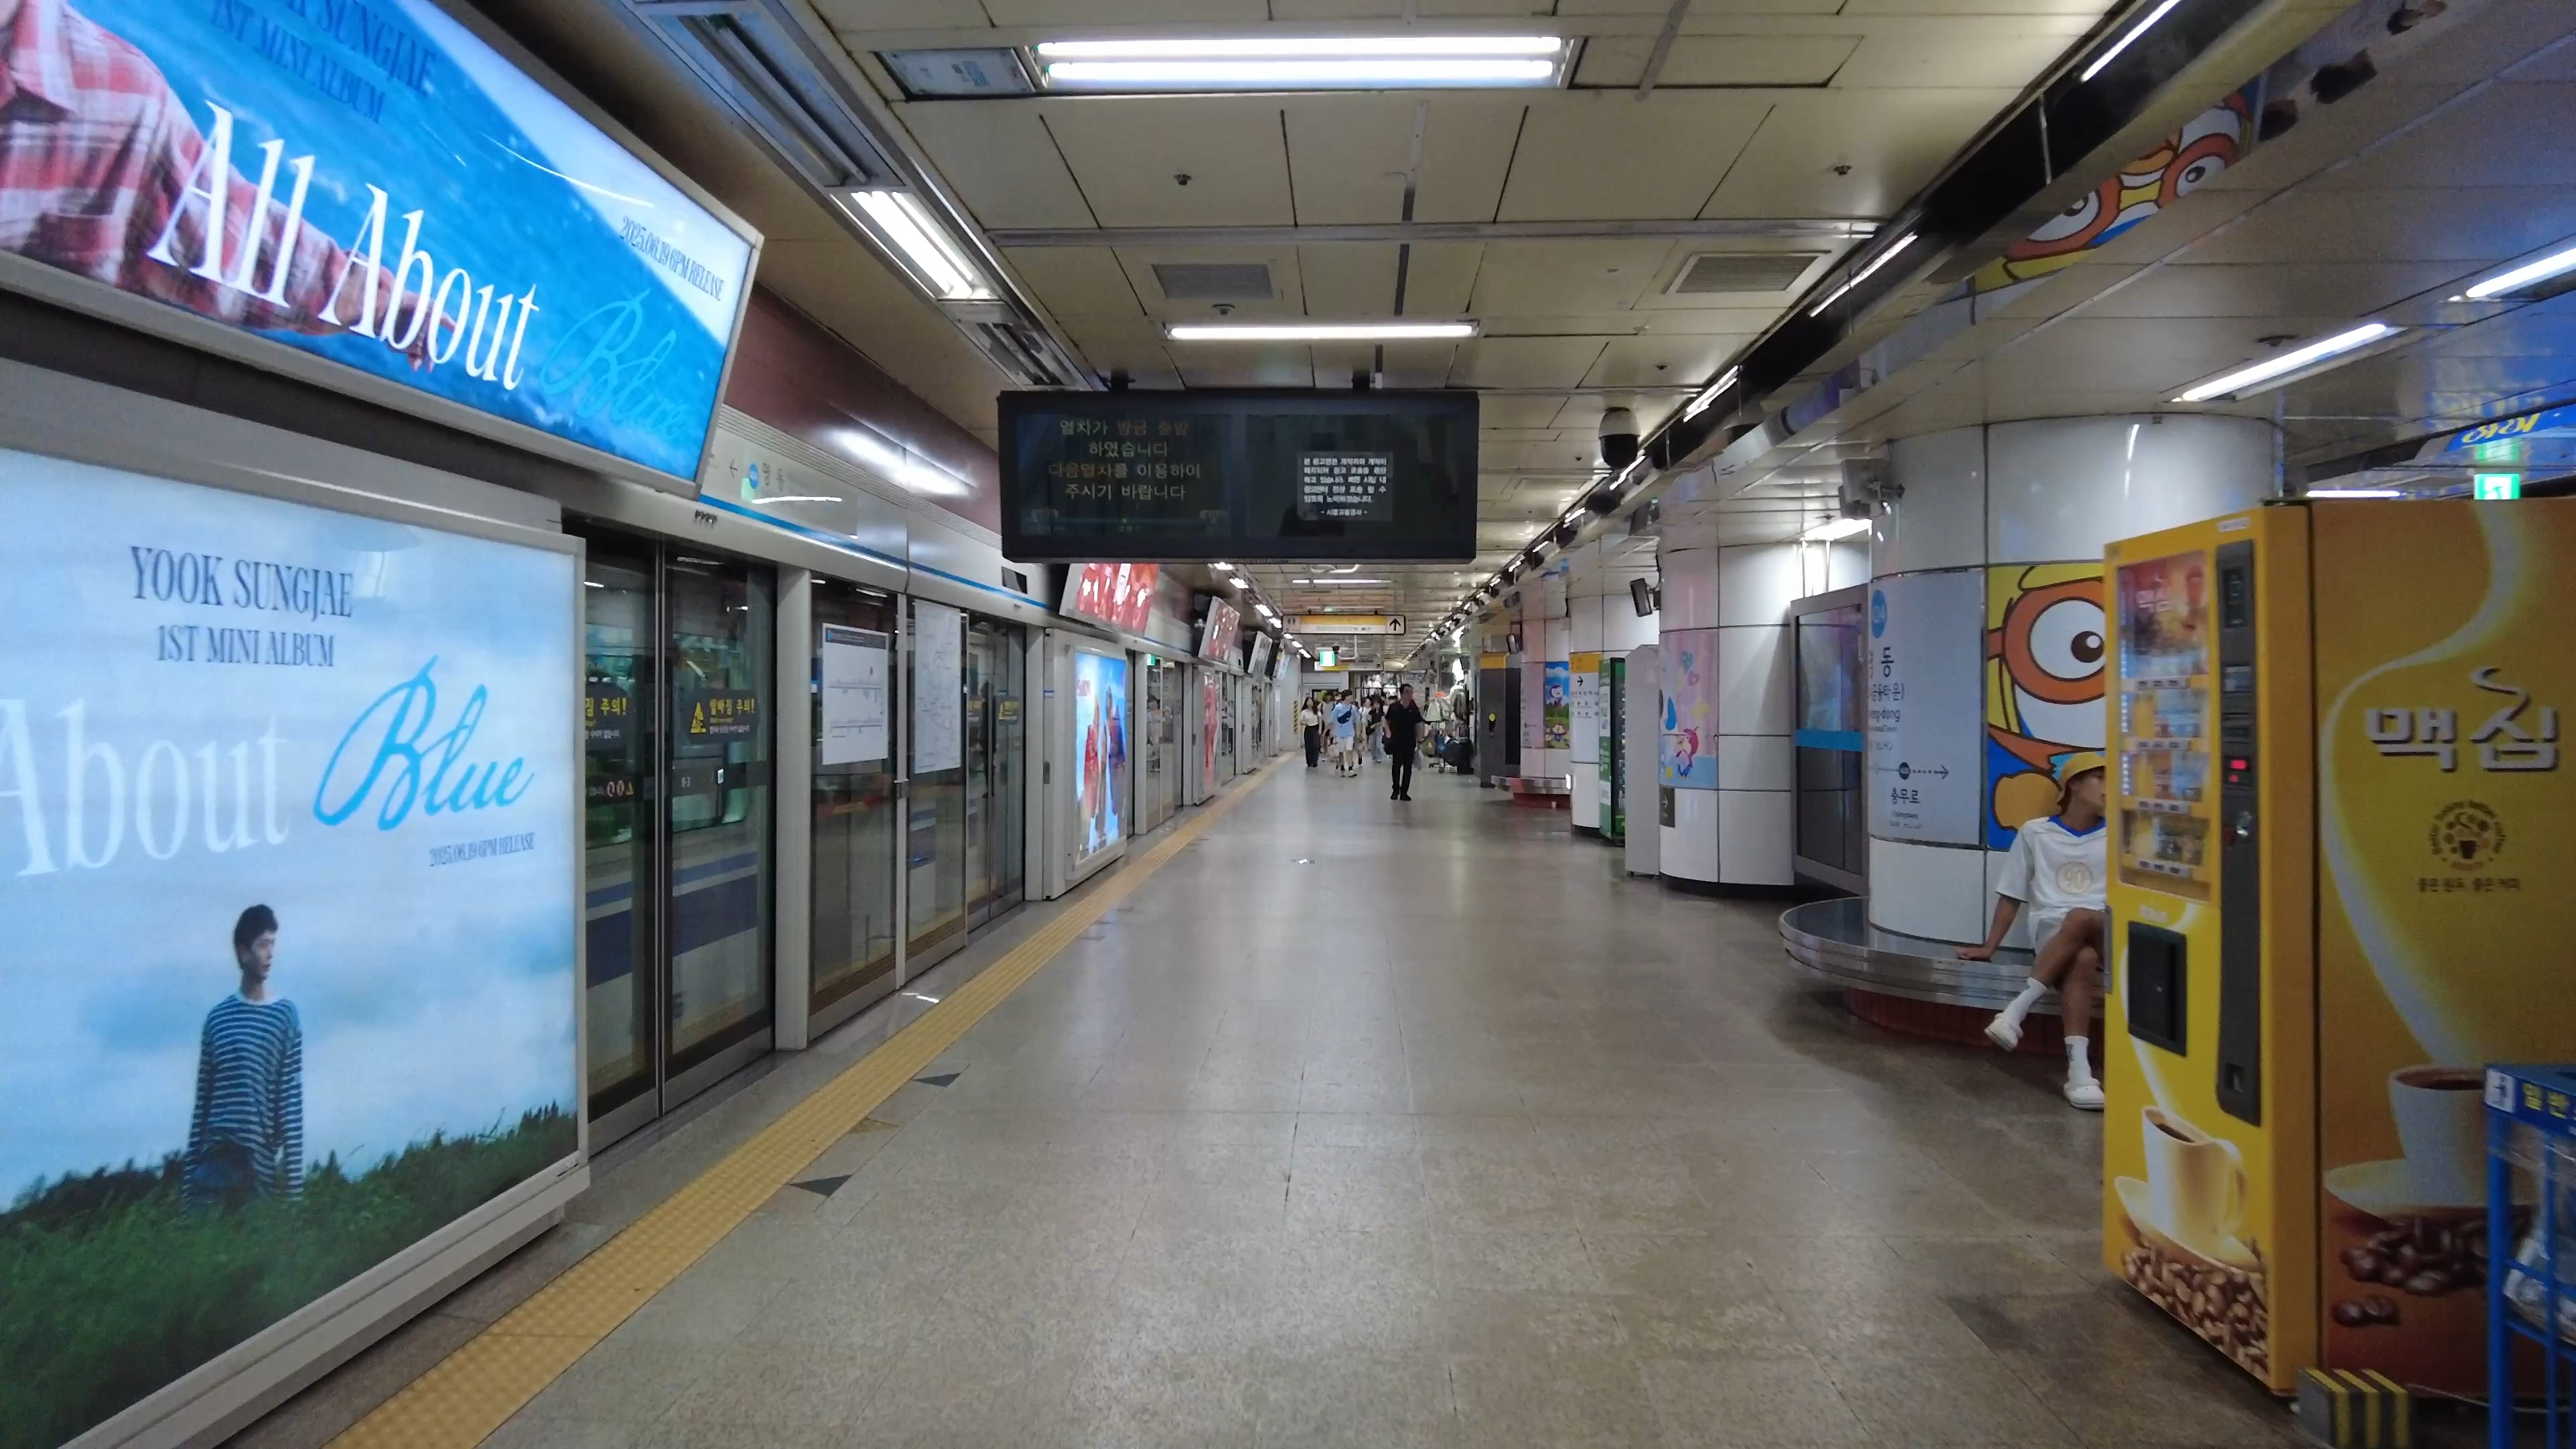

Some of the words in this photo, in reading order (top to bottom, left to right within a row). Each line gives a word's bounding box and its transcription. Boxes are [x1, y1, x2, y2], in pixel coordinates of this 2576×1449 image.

[146, 99, 316, 308] All
[318, 182, 539, 390] About
[539, 288, 692, 440] Blue
[620, 215, 671, 266] 2025.06.19
[669, 248, 691, 280] 6PM
[687, 260, 725, 302] RELEASE
[1065, 483, 1112, 500] 주시기
[1121, 483, 1186, 501] 바랍니다
[129, 545, 224, 606] YOOK
[233, 559, 353, 622] SUNGJAE
[157, 625, 199, 662] 1ST
[206, 627, 261, 663] MINI
[266, 631, 335, 667] ALBUM
[2365, 667, 2559, 773] 맥심
[0, 698, 290, 878] About
[313, 655, 535, 831] Blue
[1890, 787, 1920, 805] 충무로
